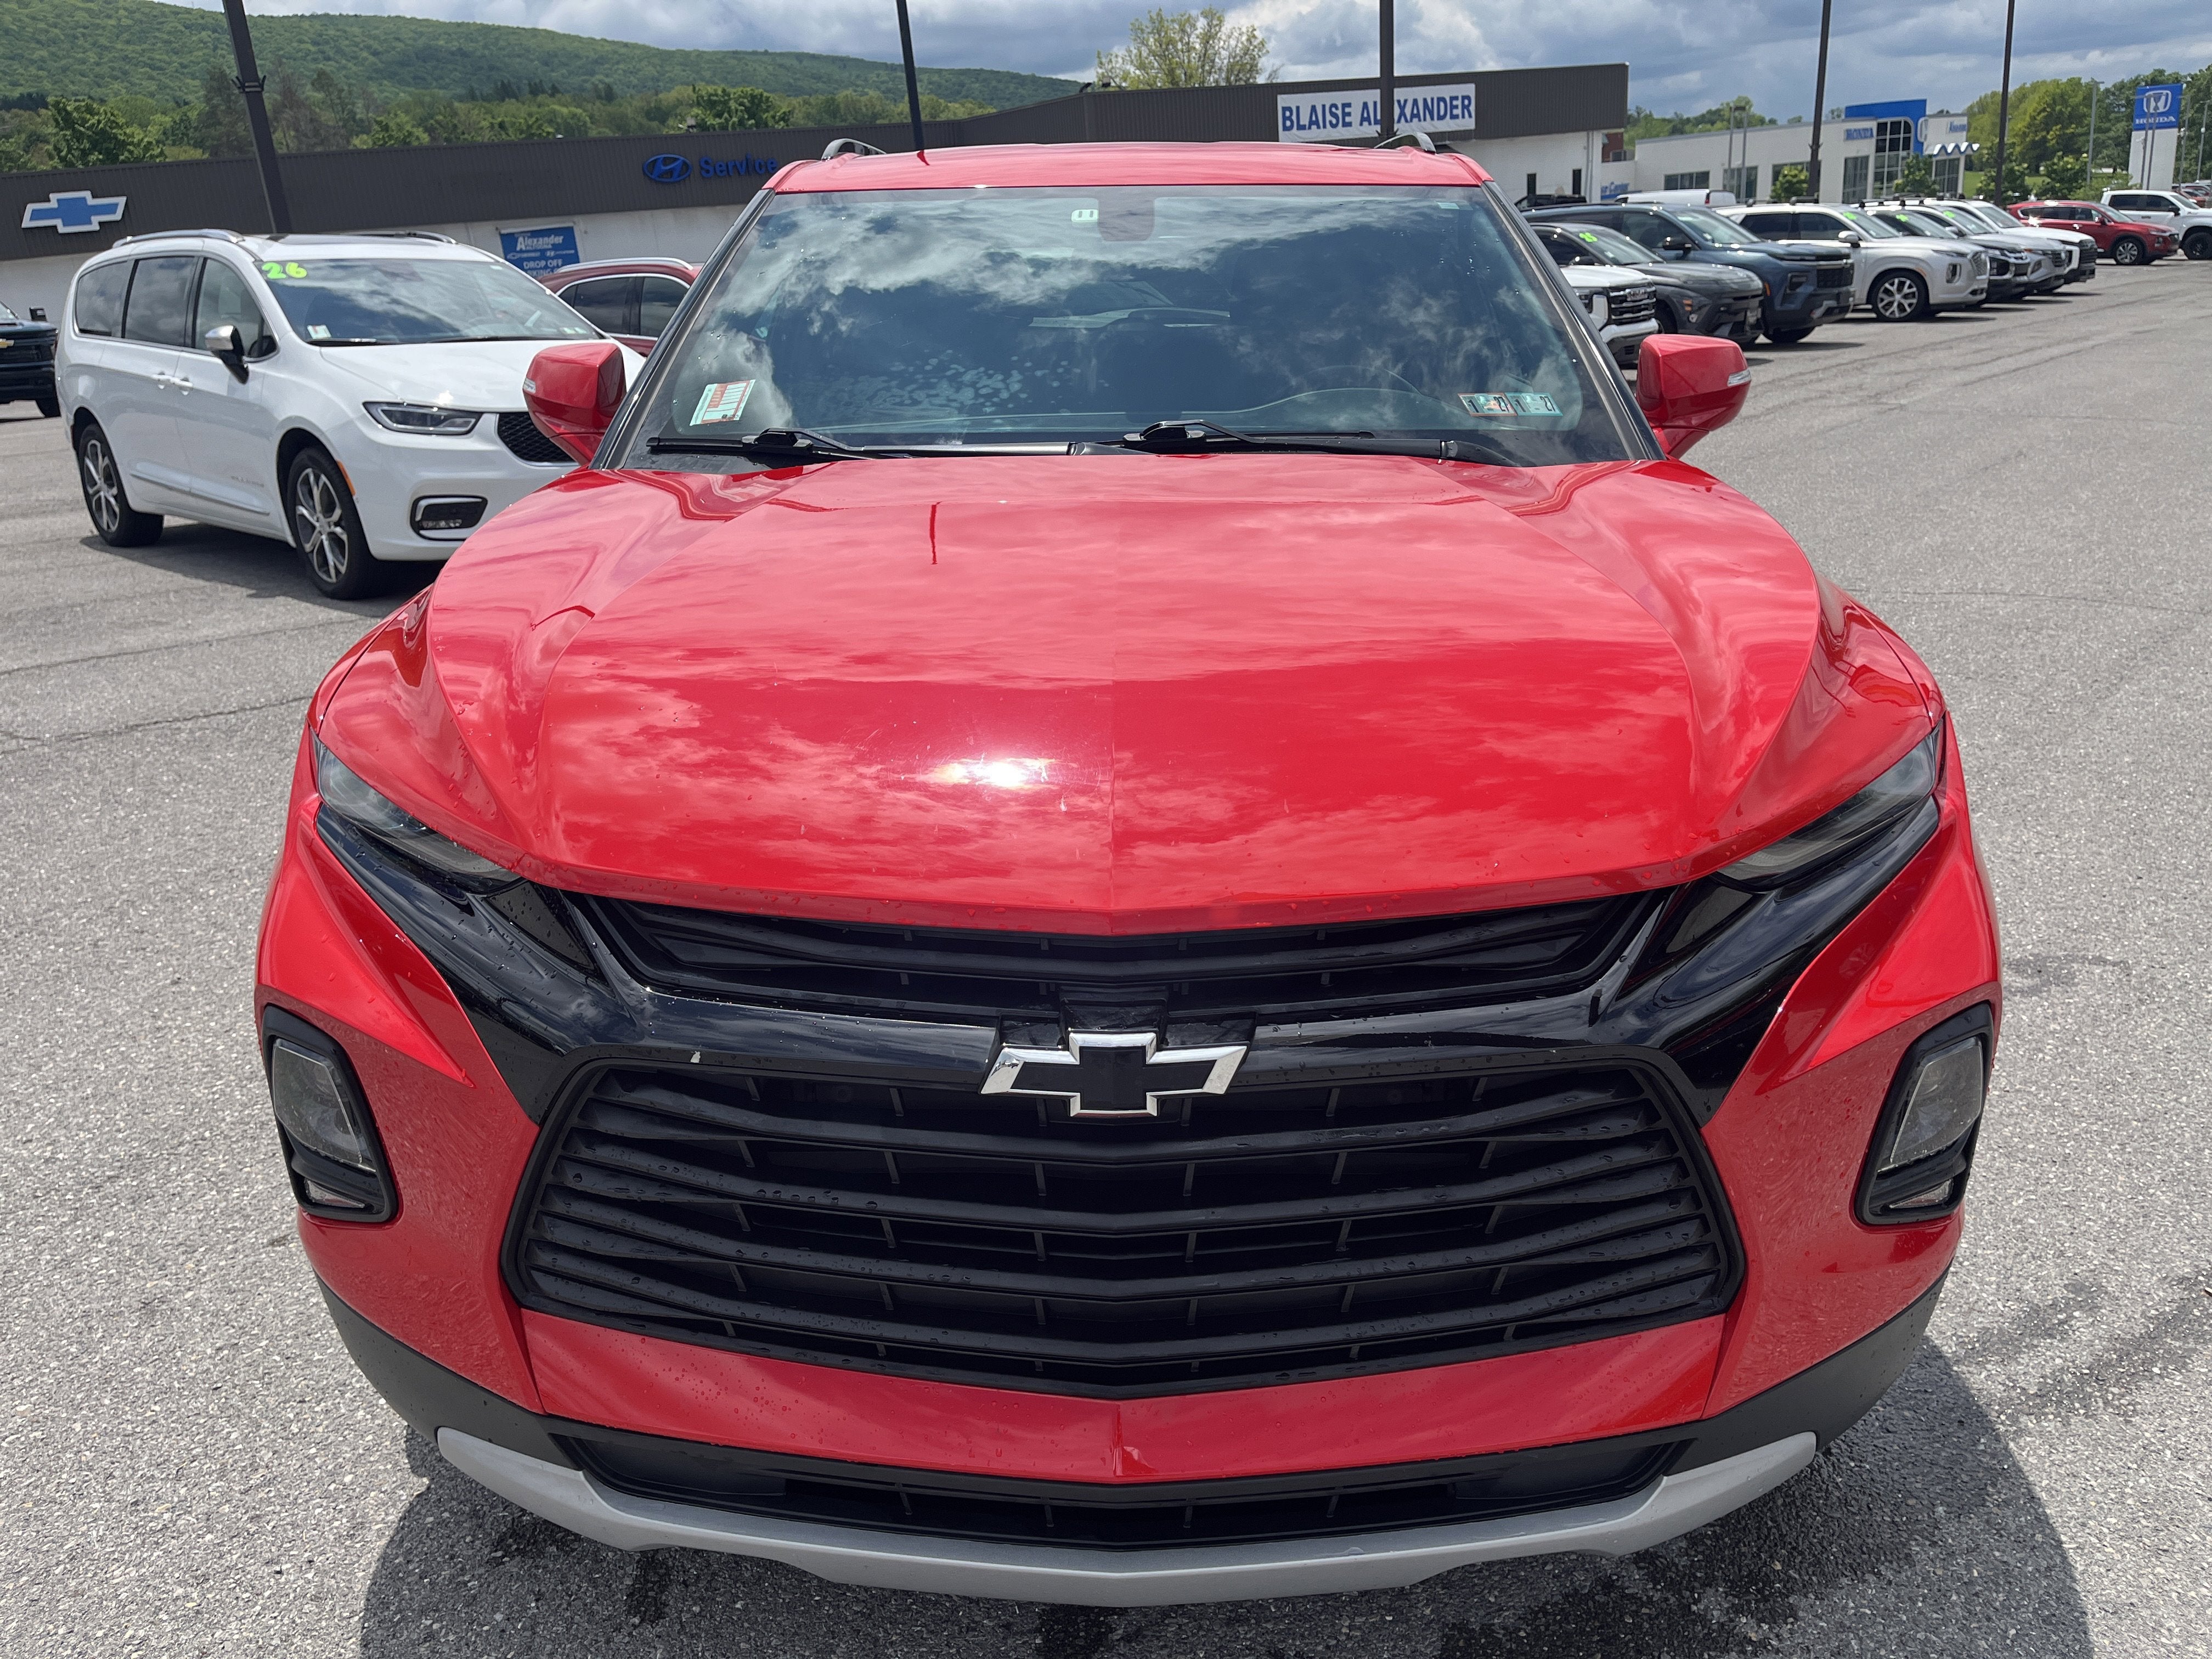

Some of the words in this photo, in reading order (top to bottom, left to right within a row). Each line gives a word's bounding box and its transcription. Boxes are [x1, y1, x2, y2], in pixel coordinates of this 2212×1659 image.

[1281, 102, 1352, 132] BLAISE
[1359, 95, 1472, 127] ALXANDER
[699, 153, 778, 178] Service
[516, 234, 564, 251] Alexander
[261, 262, 307, 279] 26
[523, 259, 546, 270] DROP
[548, 258, 563, 268] OFF
[1493, 396, 1509, 412] 27
[1539, 396, 1556, 411] 27
